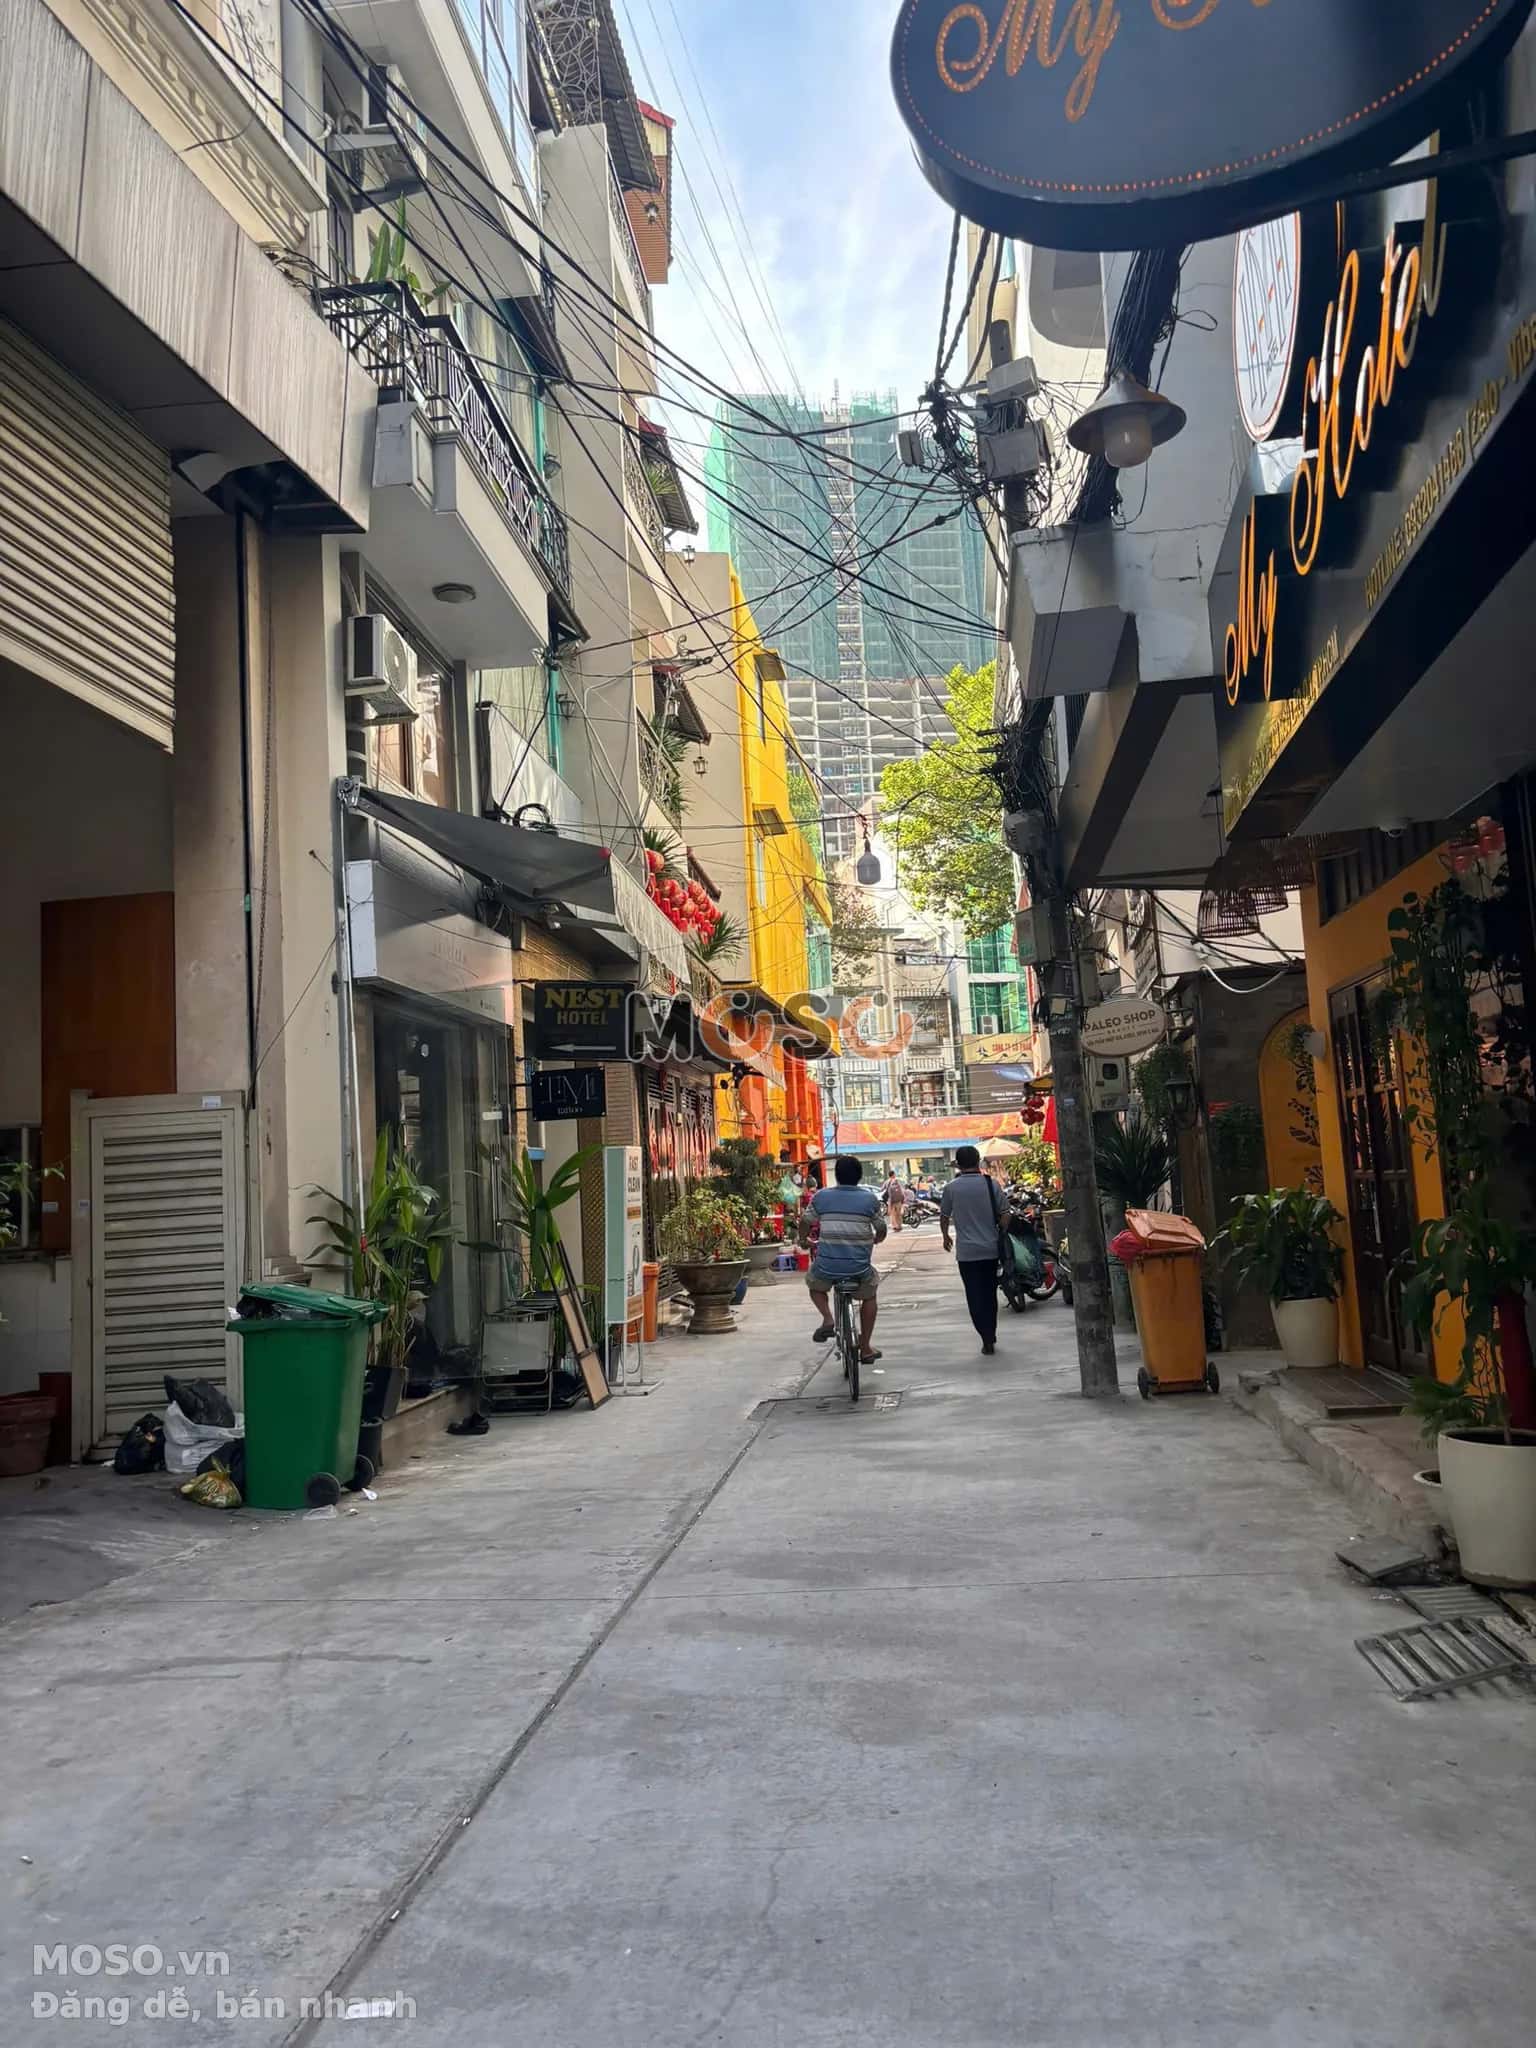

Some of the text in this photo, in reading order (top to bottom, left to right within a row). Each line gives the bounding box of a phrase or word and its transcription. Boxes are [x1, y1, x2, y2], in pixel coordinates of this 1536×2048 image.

[936, 0, 1120, 122] My
[1223, 496, 1278, 706] My
[1289, 131, 1448, 577] Hotel
[544, 988, 624, 1009] NEST
[557, 1010, 609, 1025] HOTEL
[1083, 1016, 1122, 1033] PALEO
[1123, 1009, 1157, 1025] SHOP
